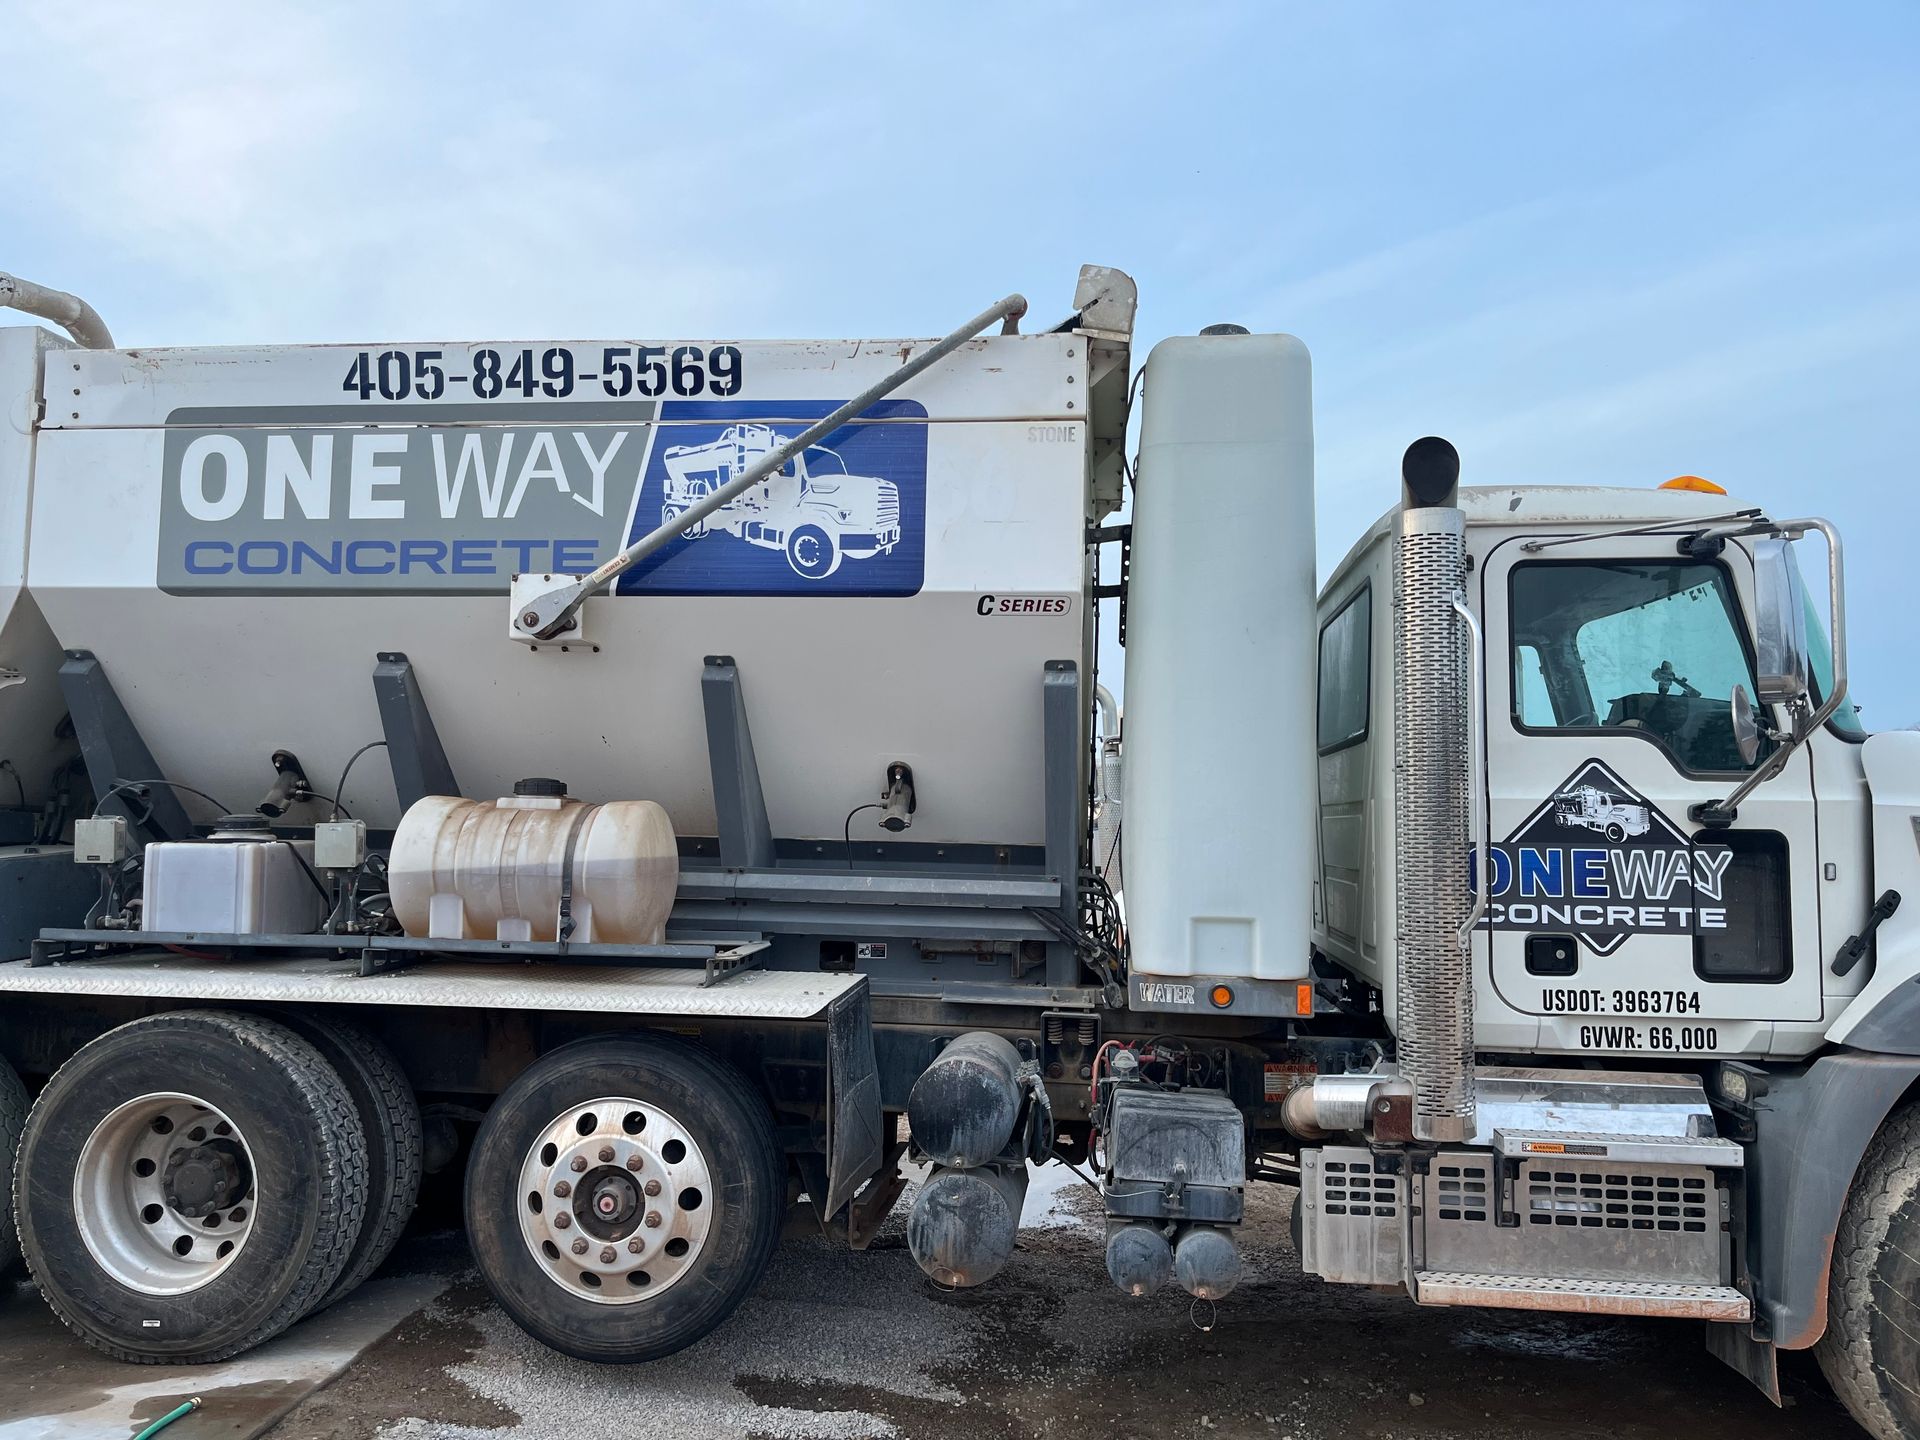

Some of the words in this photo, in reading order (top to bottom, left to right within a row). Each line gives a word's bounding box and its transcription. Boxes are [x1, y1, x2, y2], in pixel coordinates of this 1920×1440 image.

[342, 346, 743, 401] 405-849-5569
[1028, 426, 1076, 443] STONE
[180, 432, 409, 522] ONE
[431, 431, 630, 519] WAY
[184, 539, 600, 575] CONCRETE
[977, 594, 995, 616] C
[999, 599, 1066, 613] SERIES
[1473, 903, 1728, 928] CONCRETE
[1139, 982, 1195, 1005] WATER
[1543, 988, 1606, 1012] USDOT:
[1612, 990, 1701, 1014] 3963764
[1580, 1025, 1642, 1049] GVWR:
[1649, 1026, 1718, 1053] 66,000
[1274, 1064, 1316, 1073] WARNING
